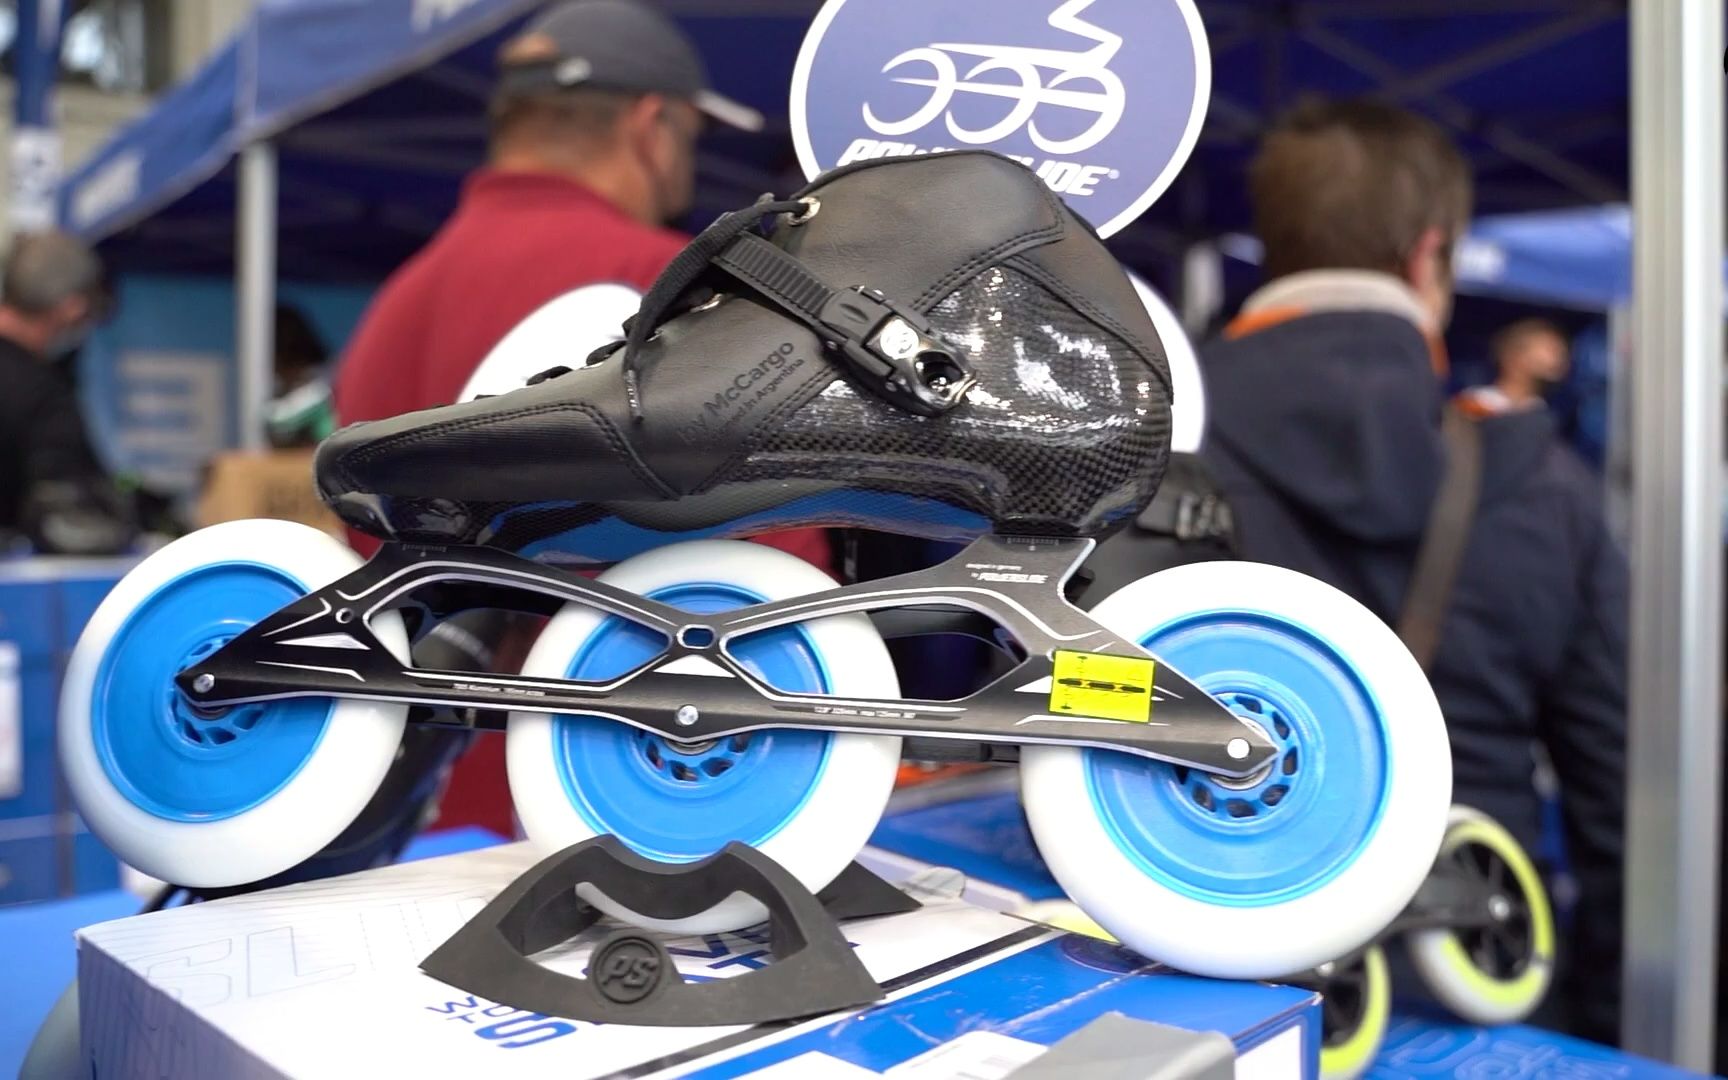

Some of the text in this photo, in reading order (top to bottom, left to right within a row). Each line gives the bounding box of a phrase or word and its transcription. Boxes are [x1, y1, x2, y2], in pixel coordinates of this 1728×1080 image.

[703, 342, 795, 417] McCargo
[756, 358, 805, 401] Argentina
[602, 955, 659, 989] PS
